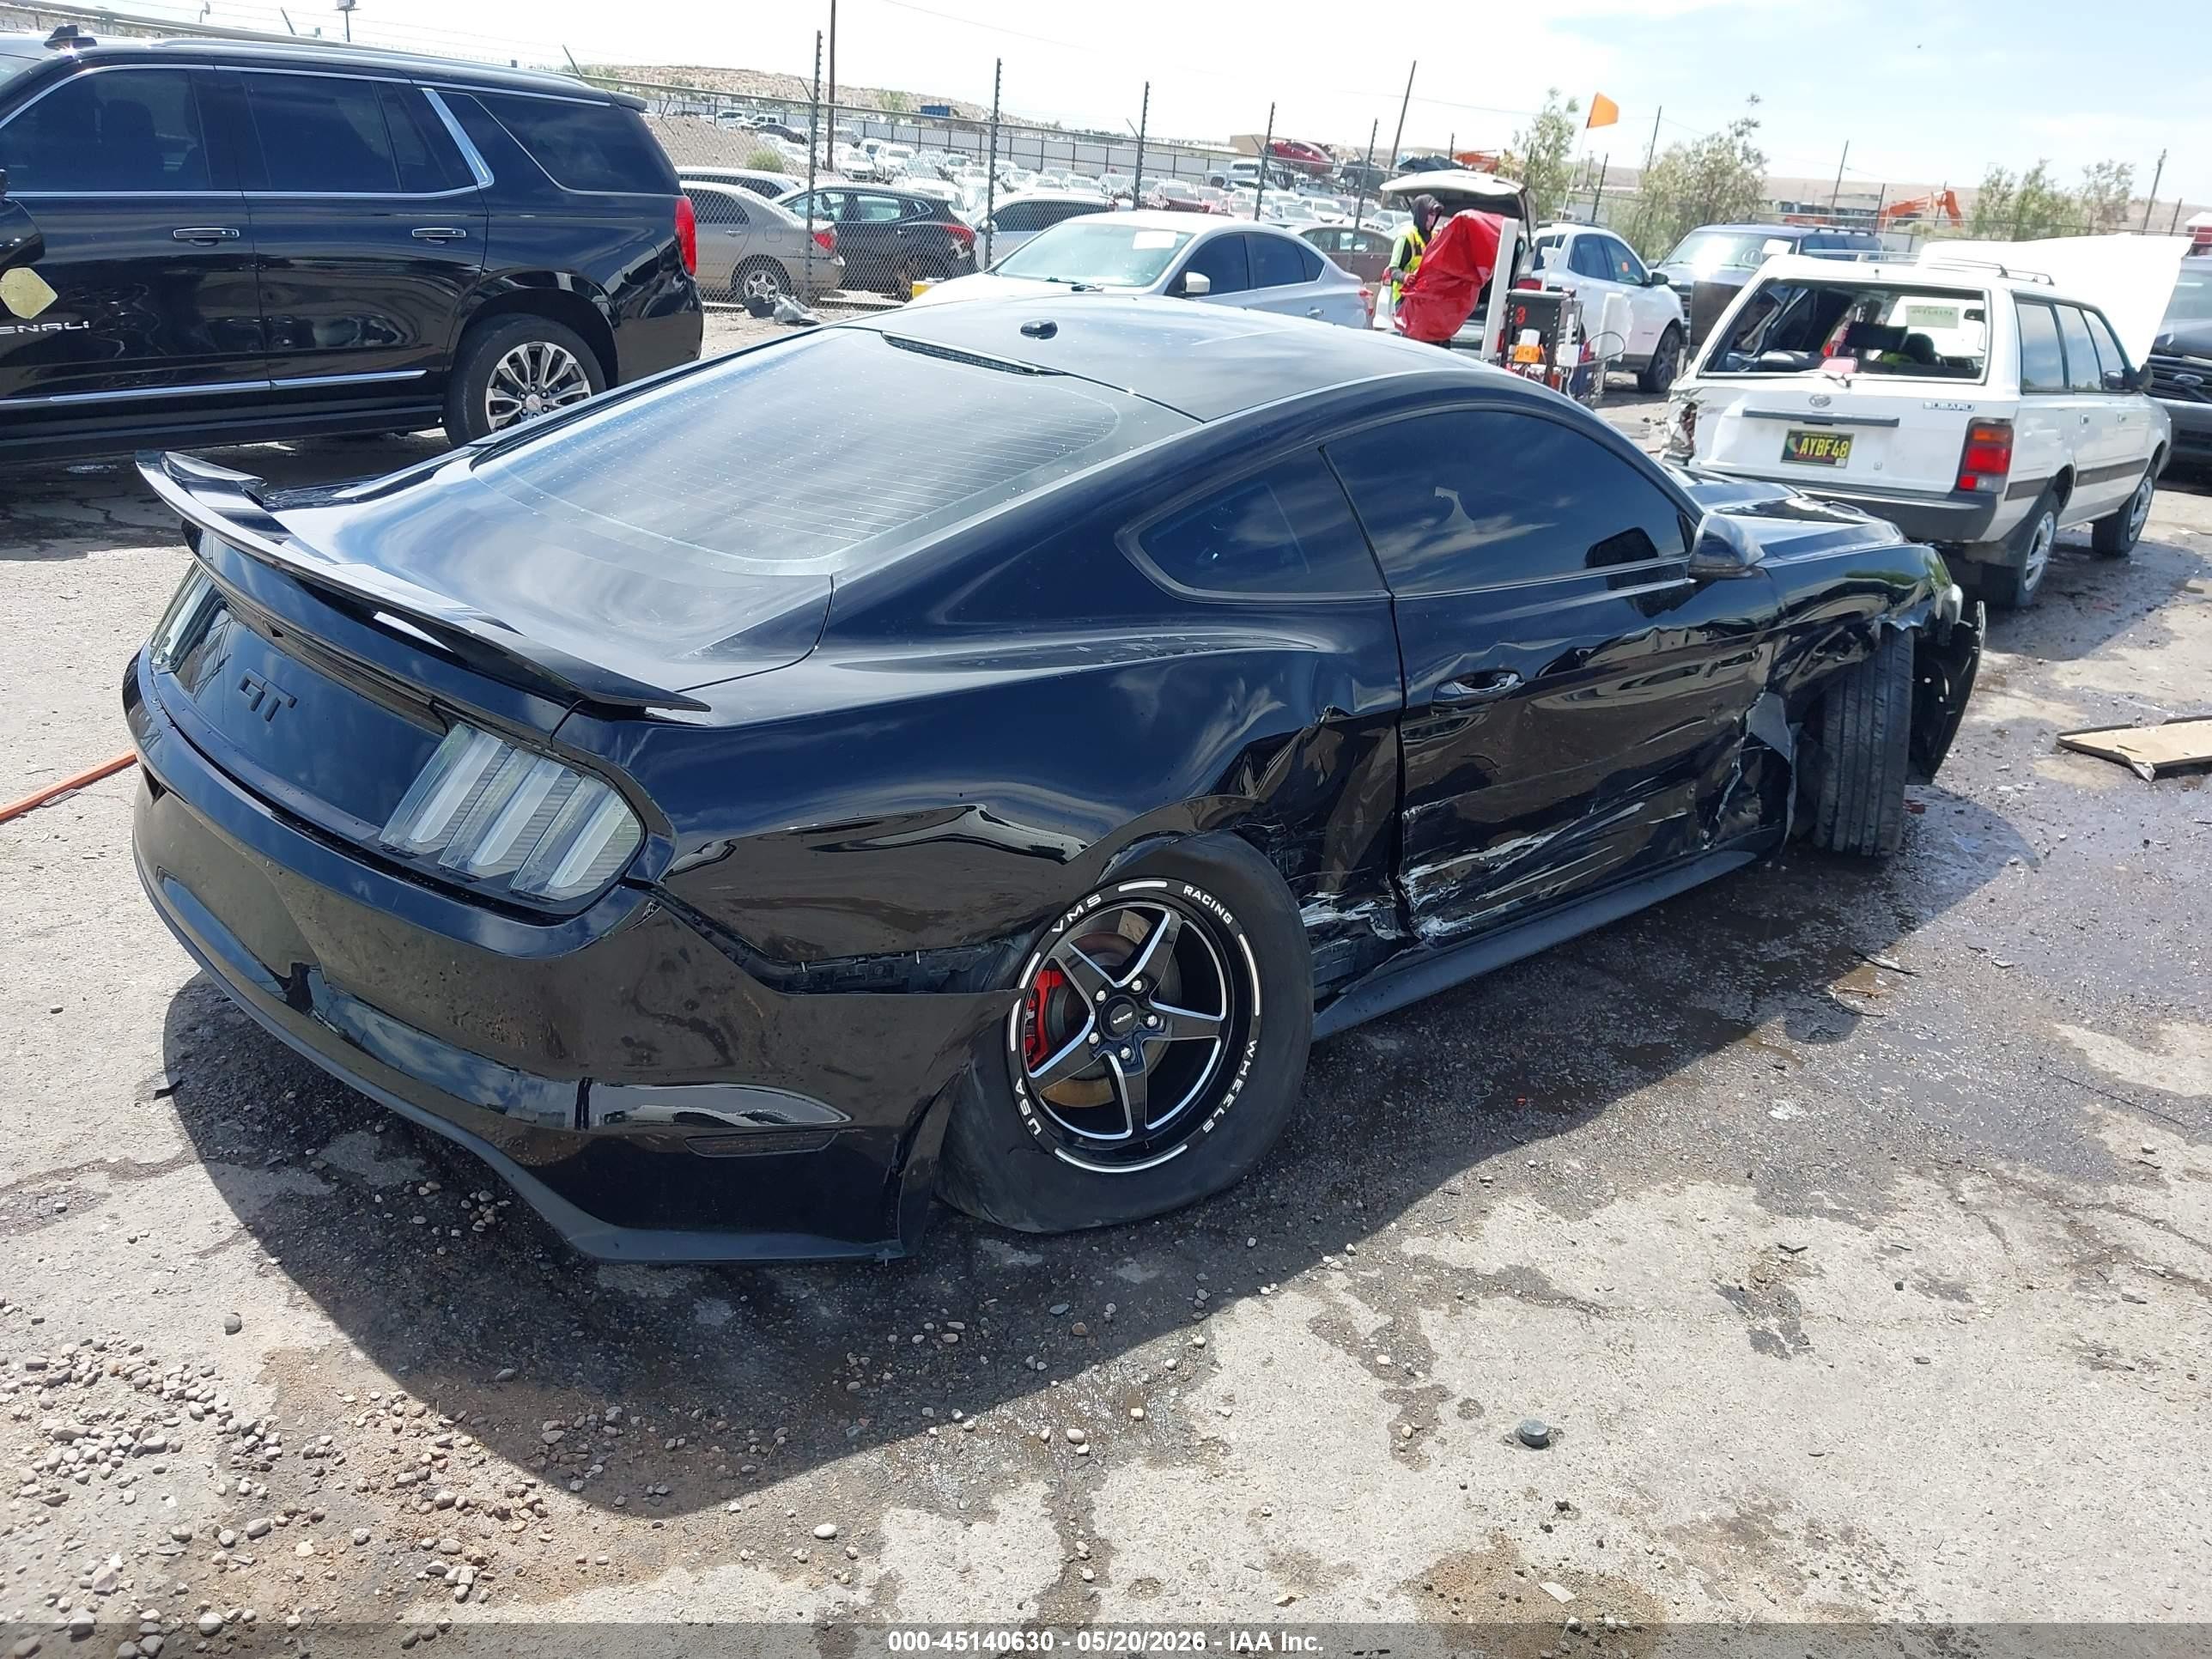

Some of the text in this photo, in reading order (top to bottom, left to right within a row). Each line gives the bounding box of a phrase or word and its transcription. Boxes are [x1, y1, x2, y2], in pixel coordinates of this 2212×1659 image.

[1799, 437, 1850, 458] AYBF48
[239, 667, 298, 722] GT
[1015, 884, 1257, 1136] VMS RACING WHEELS USA
